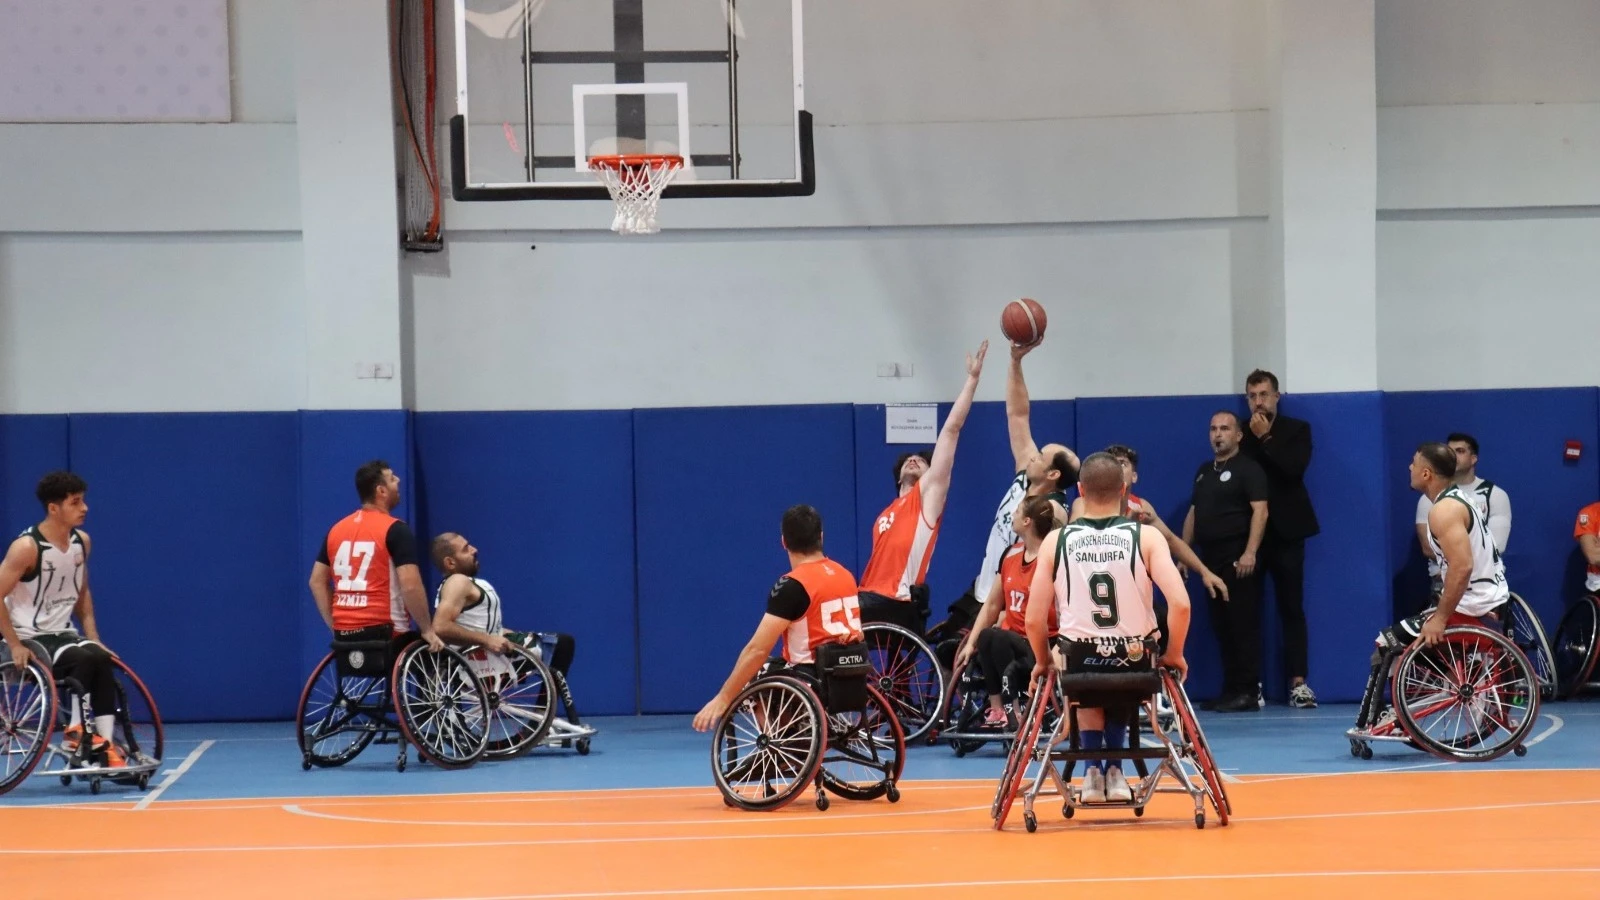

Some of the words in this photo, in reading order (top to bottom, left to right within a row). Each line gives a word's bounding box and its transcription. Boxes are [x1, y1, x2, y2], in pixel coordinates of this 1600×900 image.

[333, 541, 375, 591] 47
[1010, 590, 1025, 612] 17
[1087, 571, 1120, 629] 9
[839, 655, 863, 665] EXTRA
[1083, 657, 1130, 667] ELITEX
